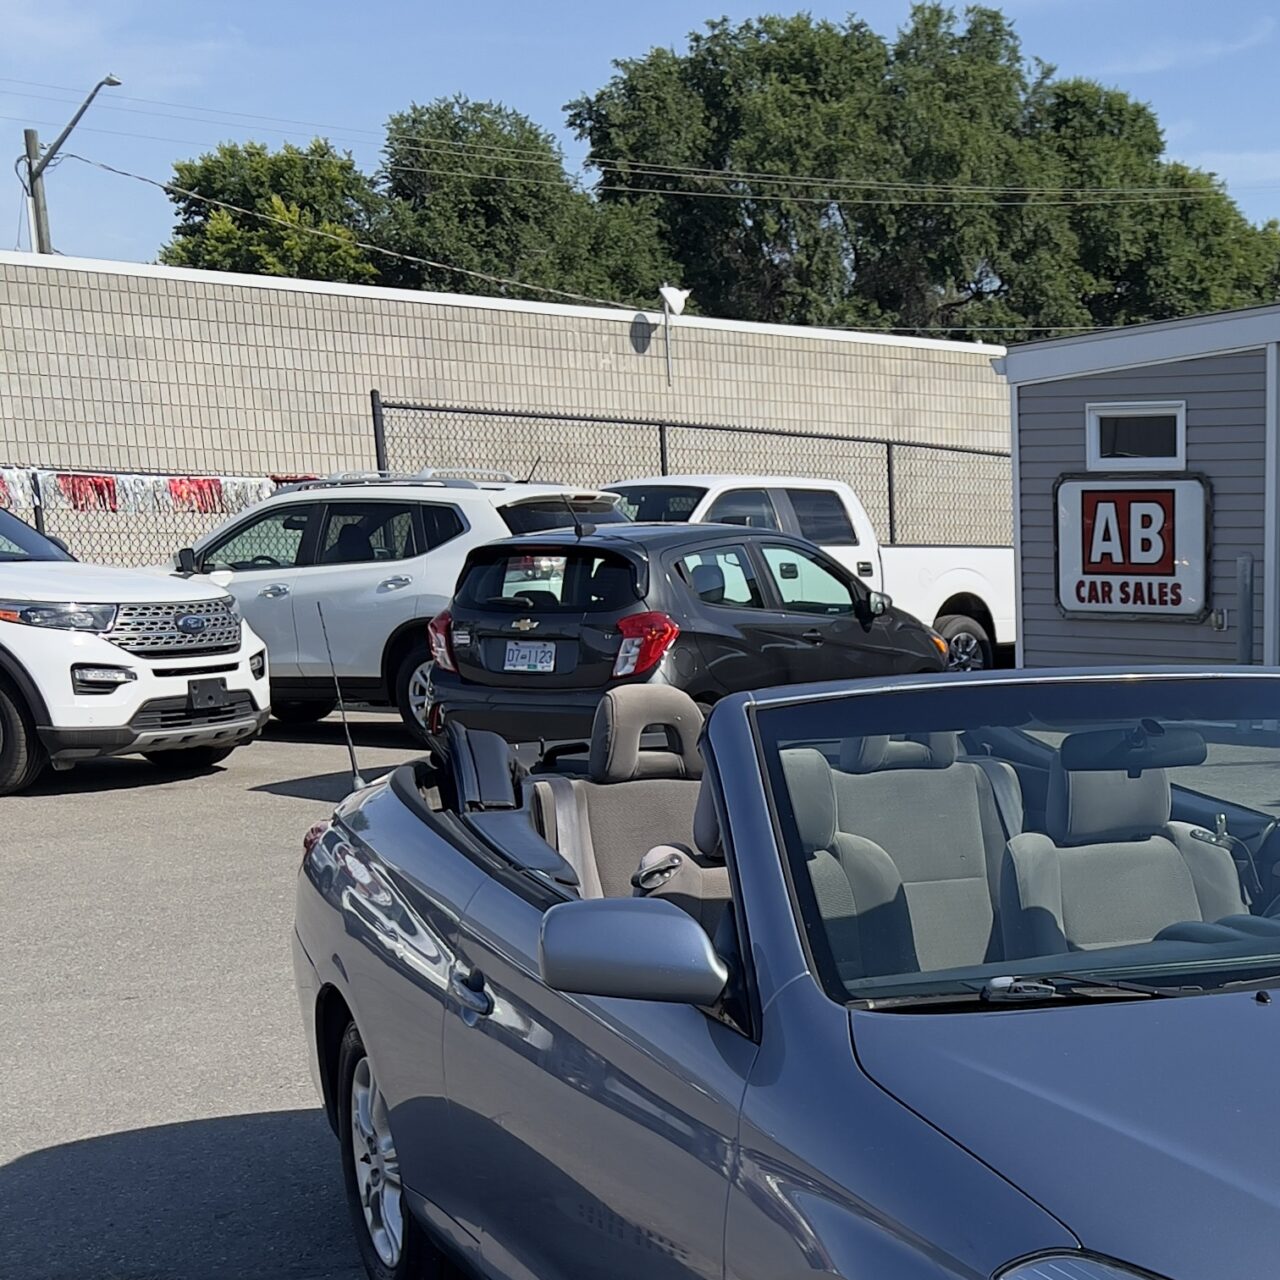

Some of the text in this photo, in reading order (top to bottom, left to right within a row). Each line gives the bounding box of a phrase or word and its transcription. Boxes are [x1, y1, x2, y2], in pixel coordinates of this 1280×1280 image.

[1089, 500, 1166, 565] AB
[1075, 580, 1182, 606] CAR SALES
